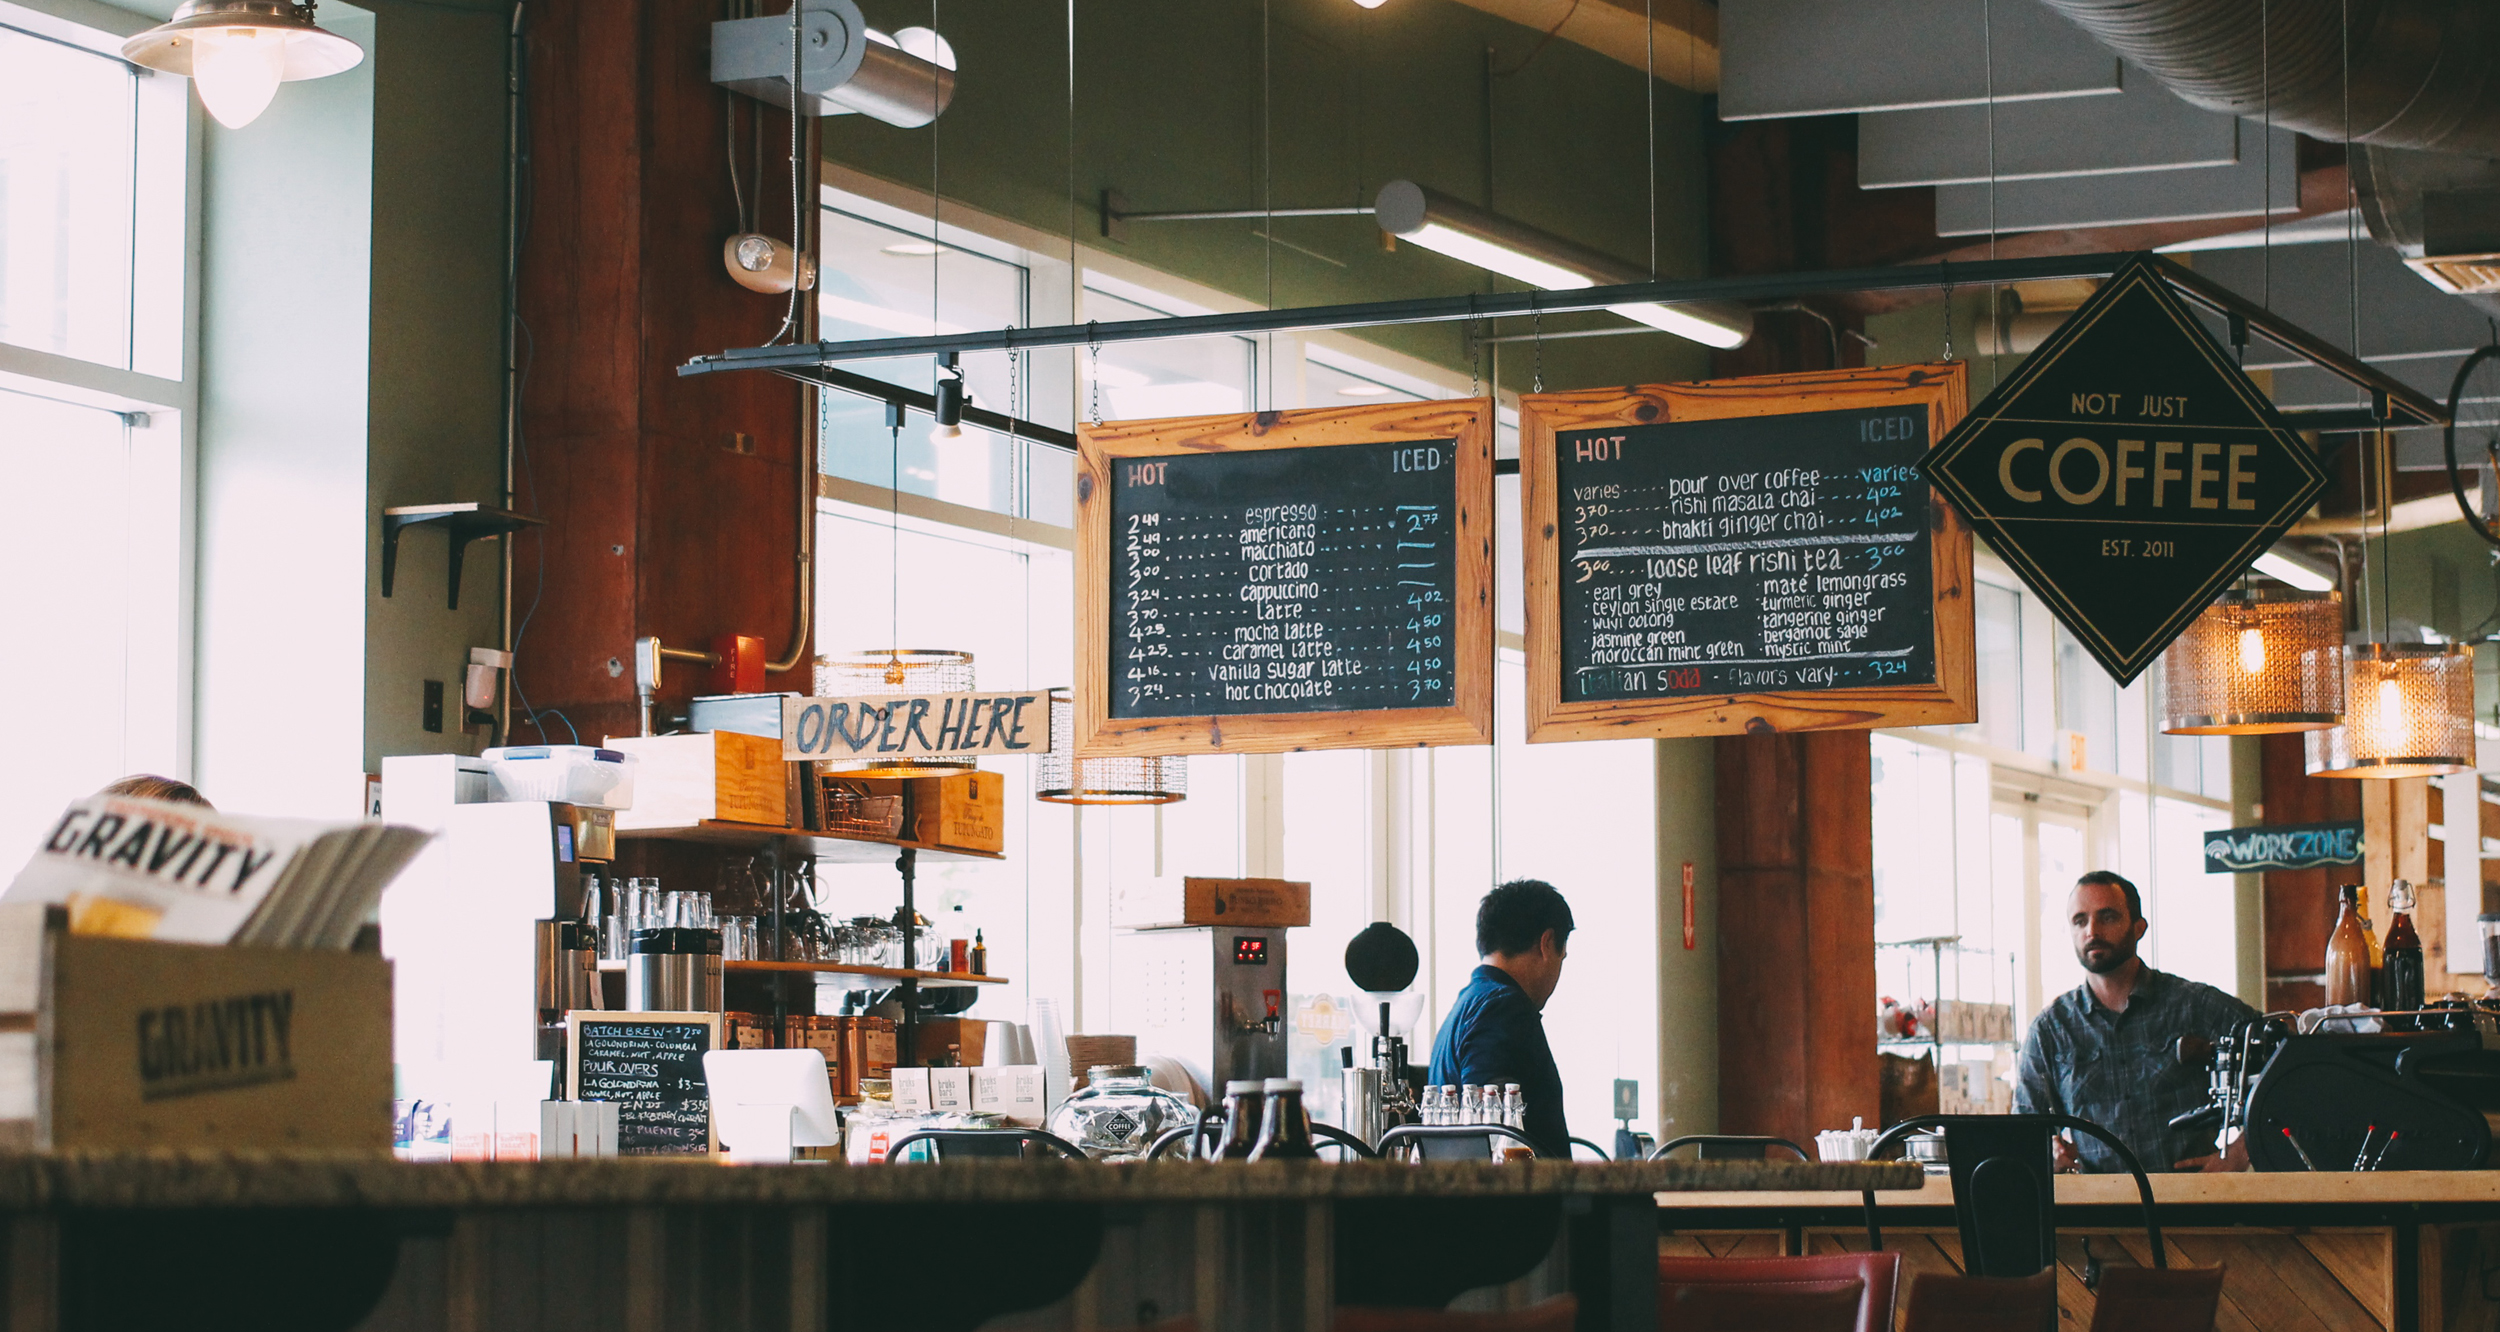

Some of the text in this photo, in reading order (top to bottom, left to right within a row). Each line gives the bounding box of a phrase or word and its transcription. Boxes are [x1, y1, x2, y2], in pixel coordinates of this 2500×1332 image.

[2071, 393, 2188, 418] NOT JUST
[1861, 417, 1913, 442] ICED
[1576, 436, 1625, 462] HOT
[1393, 448, 1440, 473] ICED
[1128, 462, 1168, 487] HOT
[1574, 465, 1919, 500] varies pour over coffee varies
[1998, 437, 2258, 510] COFFEE
[1671, 494, 1708, 515] rishi
[1712, 492, 1774, 511] masala
[1781, 487, 1815, 507] chai
[1246, 503, 1317, 525] espresso
[1663, 517, 1713, 540] bhakti
[1719, 515, 1779, 537] ginger
[1784, 509, 1824, 531] chai
[1240, 522, 1315, 543] americano
[1242, 541, 1315, 561] macchiato
[2101, 540, 2174, 557] EST. 2011
[1249, 561, 1308, 582] cortado
[1647, 557, 1697, 579] loose
[1706, 550, 1740, 576] leaf
[1750, 548, 1797, 572] rishi
[1804, 544, 1843, 571] tea
[1241, 581, 1318, 602] cappuccino
[1593, 583, 1662, 602] earl grey
[1817, 572, 1906, 594] lemongrass
[1257, 601, 1302, 620] latte
[1592, 594, 1738, 618] ceylon single estate
[1762, 590, 1871, 610] turmeric ginger
[1591, 613, 1674, 631] wuyi oolong
[1763, 606, 1885, 629] tangerine ginger
[1235, 625, 1279, 642] mocha
[1284, 621, 1323, 639] latte
[1591, 629, 1685, 649] jasmine green
[1764, 624, 1867, 644] bergamot sage
[1223, 642, 1285, 660] caramel
[1292, 640, 1332, 657] latte
[1591, 642, 1744, 664] moroccan mint green
[1764, 638, 1851, 657] mystic mint
[1209, 662, 1260, 680] vanilla
[1268, 663, 1314, 682] sugar
[1322, 657, 1361, 676] latte
[1657, 667, 1700, 692] soda
[1729, 666, 1787, 686] flavors
[1796, 667, 1833, 686] vary
[1226, 682, 1250, 700] hot
[1255, 680, 1332, 700] chocolate
[796, 696, 1037, 754] ORDER HERE
[45, 808, 275, 894] GRAVITY
[2227, 828, 2356, 861] WORK ZONE
[138, 988, 294, 1082] GRAVITY
[584, 1024, 621, 1036] BATCH
[626, 1026, 665, 1037] BREW
[656, 1041, 697, 1051] COLOMBIA
[584, 1060, 658, 1076] POUR OVERS
[637, 1125, 681, 1137] PUENTE
